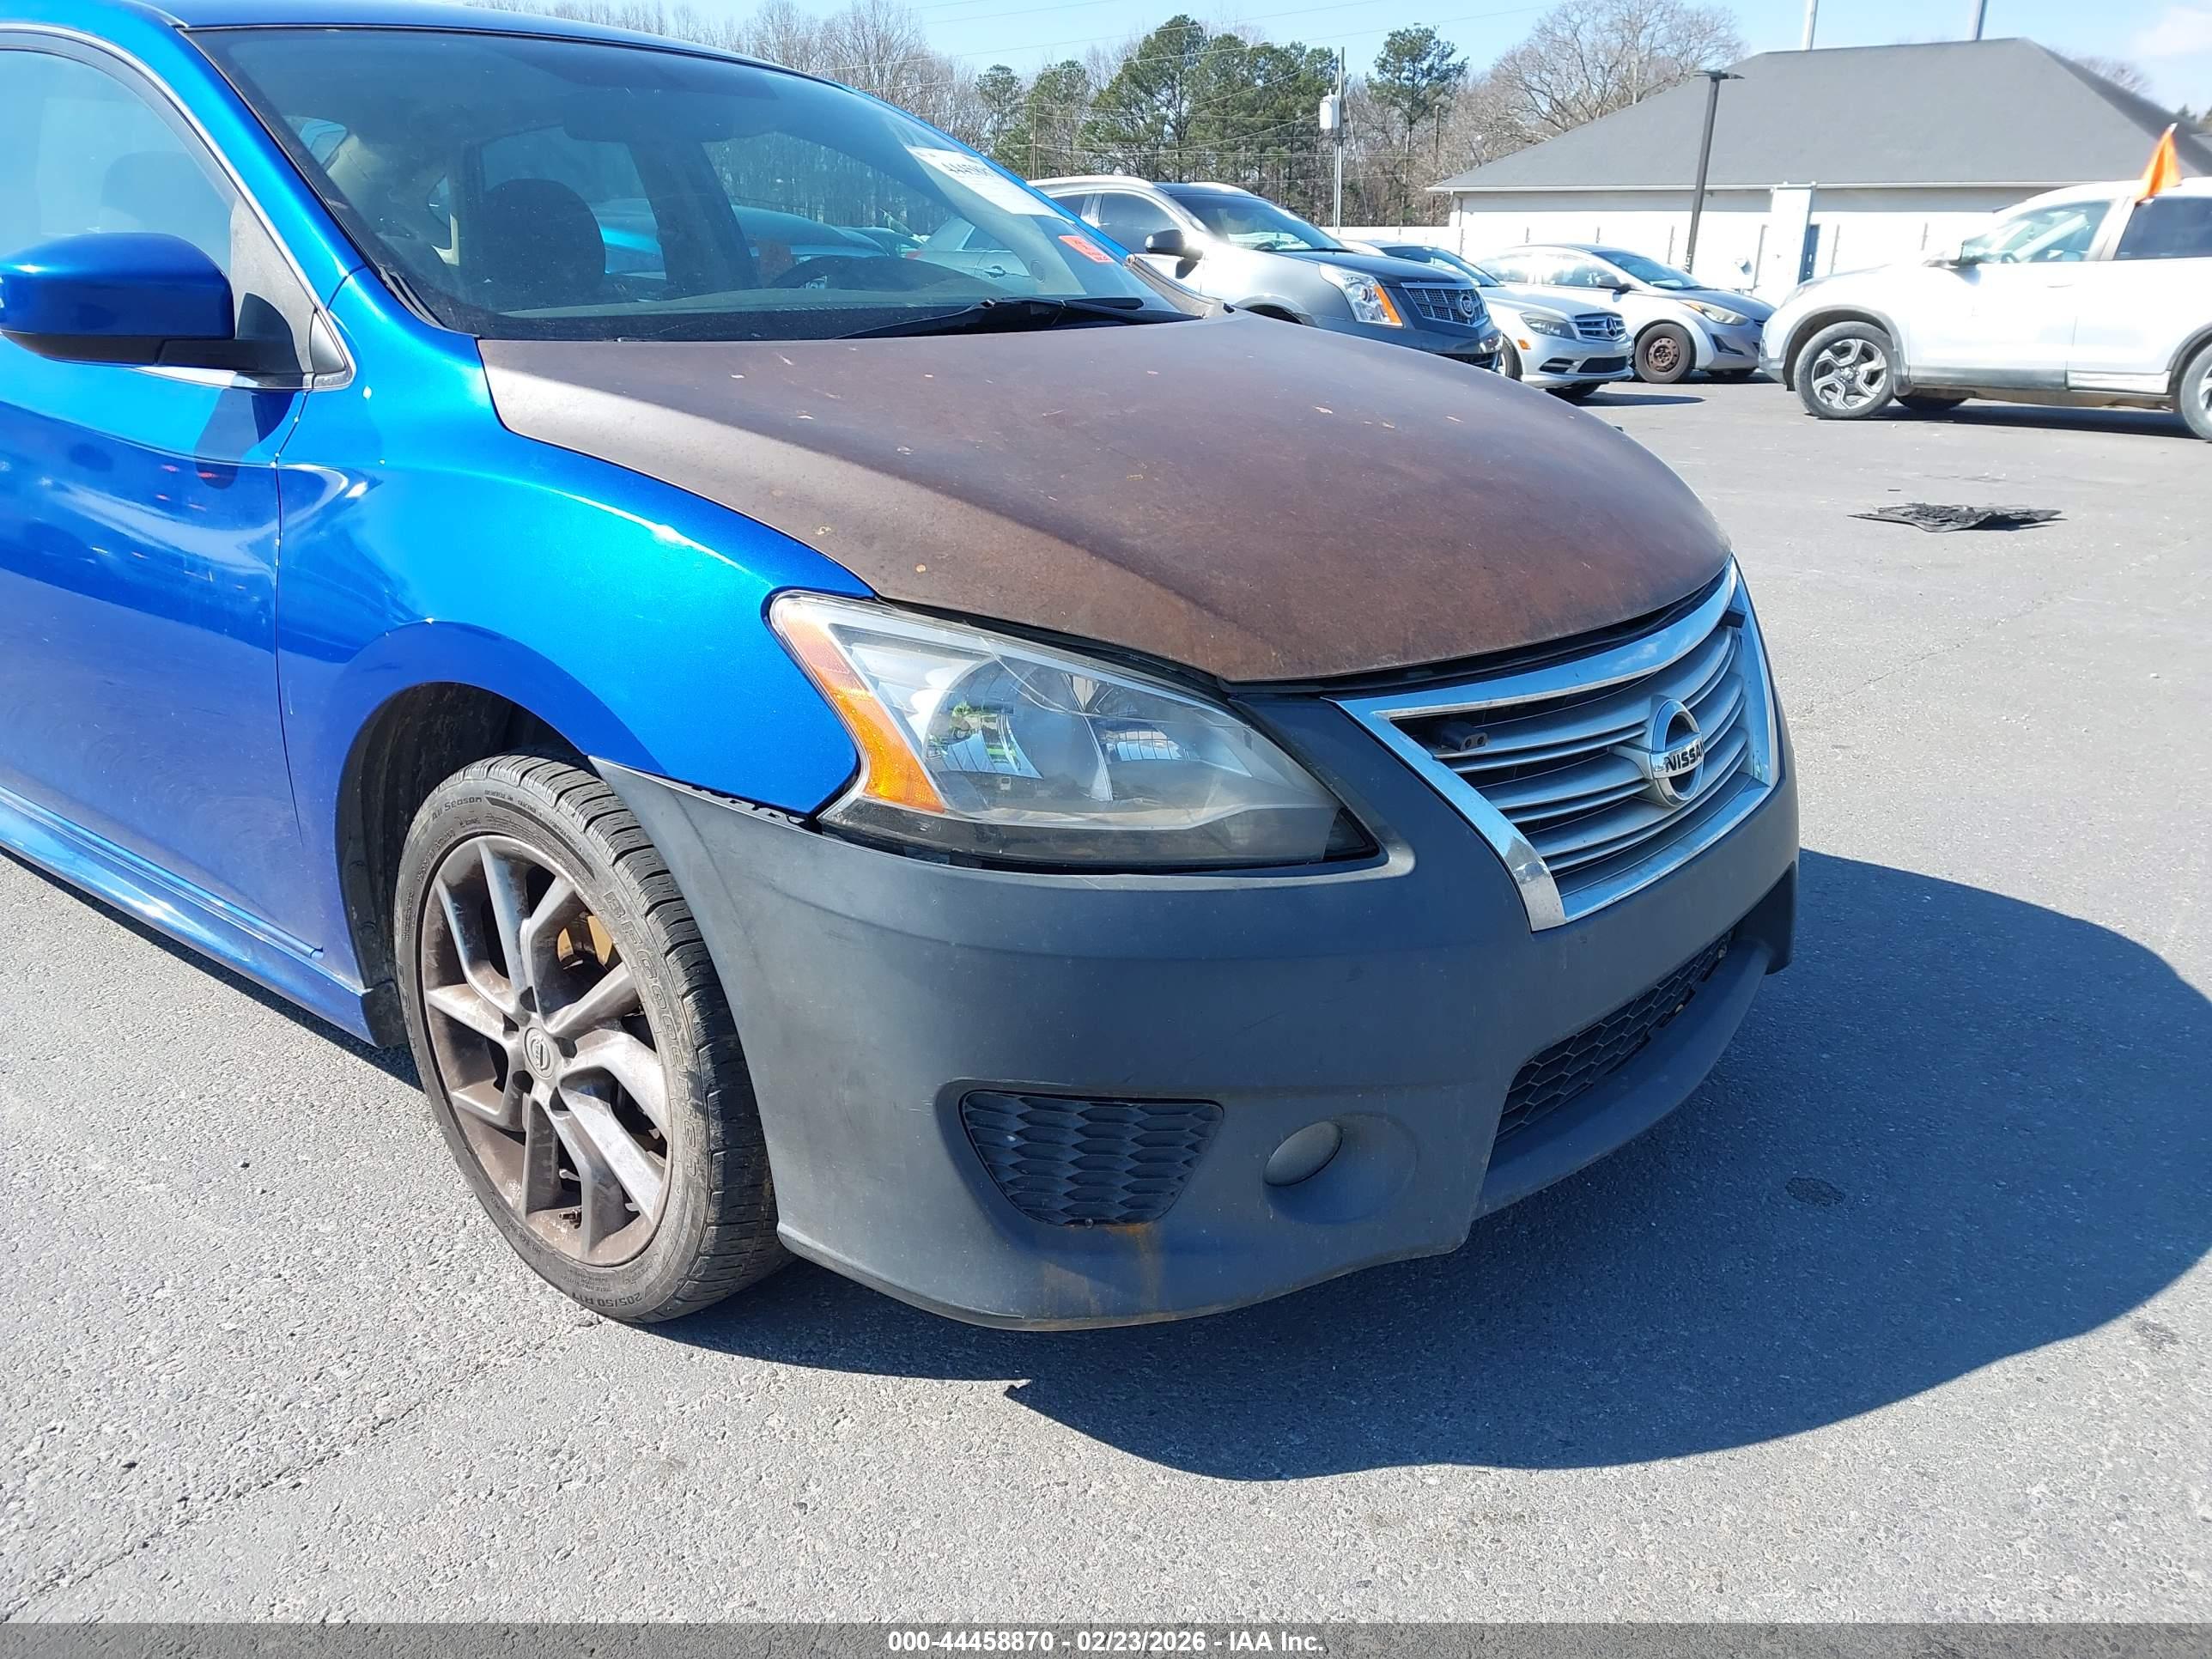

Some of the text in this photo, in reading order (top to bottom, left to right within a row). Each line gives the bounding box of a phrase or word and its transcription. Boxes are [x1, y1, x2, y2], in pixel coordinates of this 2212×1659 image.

[431, 808, 443, 822] All
[444, 796, 483, 811] Season
[597, 1291, 642, 1308] 205/50
